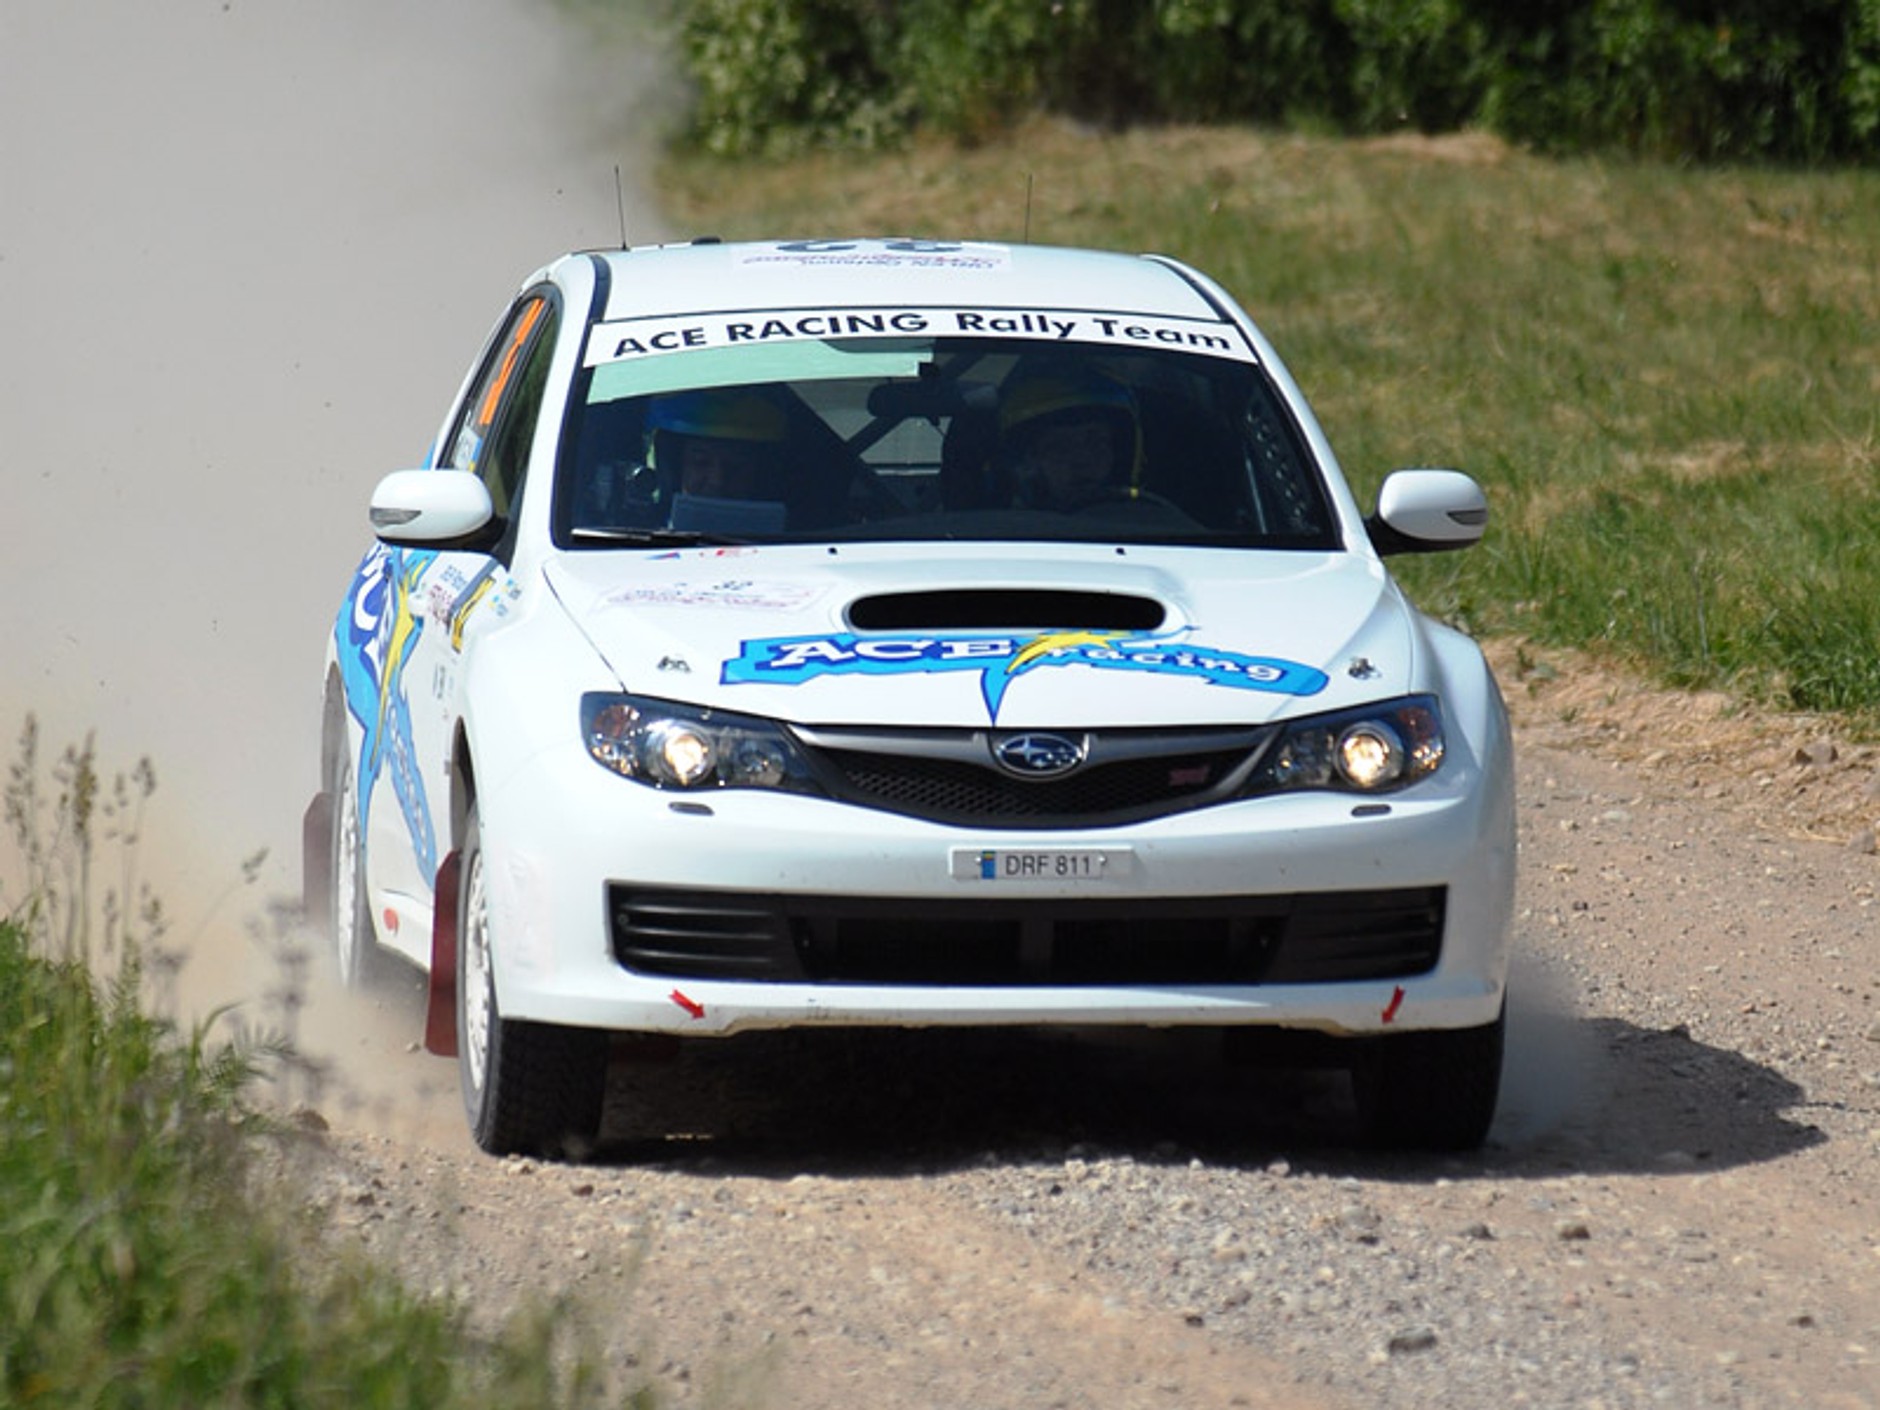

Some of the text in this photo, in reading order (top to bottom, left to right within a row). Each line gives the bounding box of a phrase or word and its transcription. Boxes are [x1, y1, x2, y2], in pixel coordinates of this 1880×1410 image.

[613, 312, 1232, 357] ACE RACING Rally Team
[764, 638, 1285, 682] ACE racing
[1005, 855, 1090, 875] DRF 811
